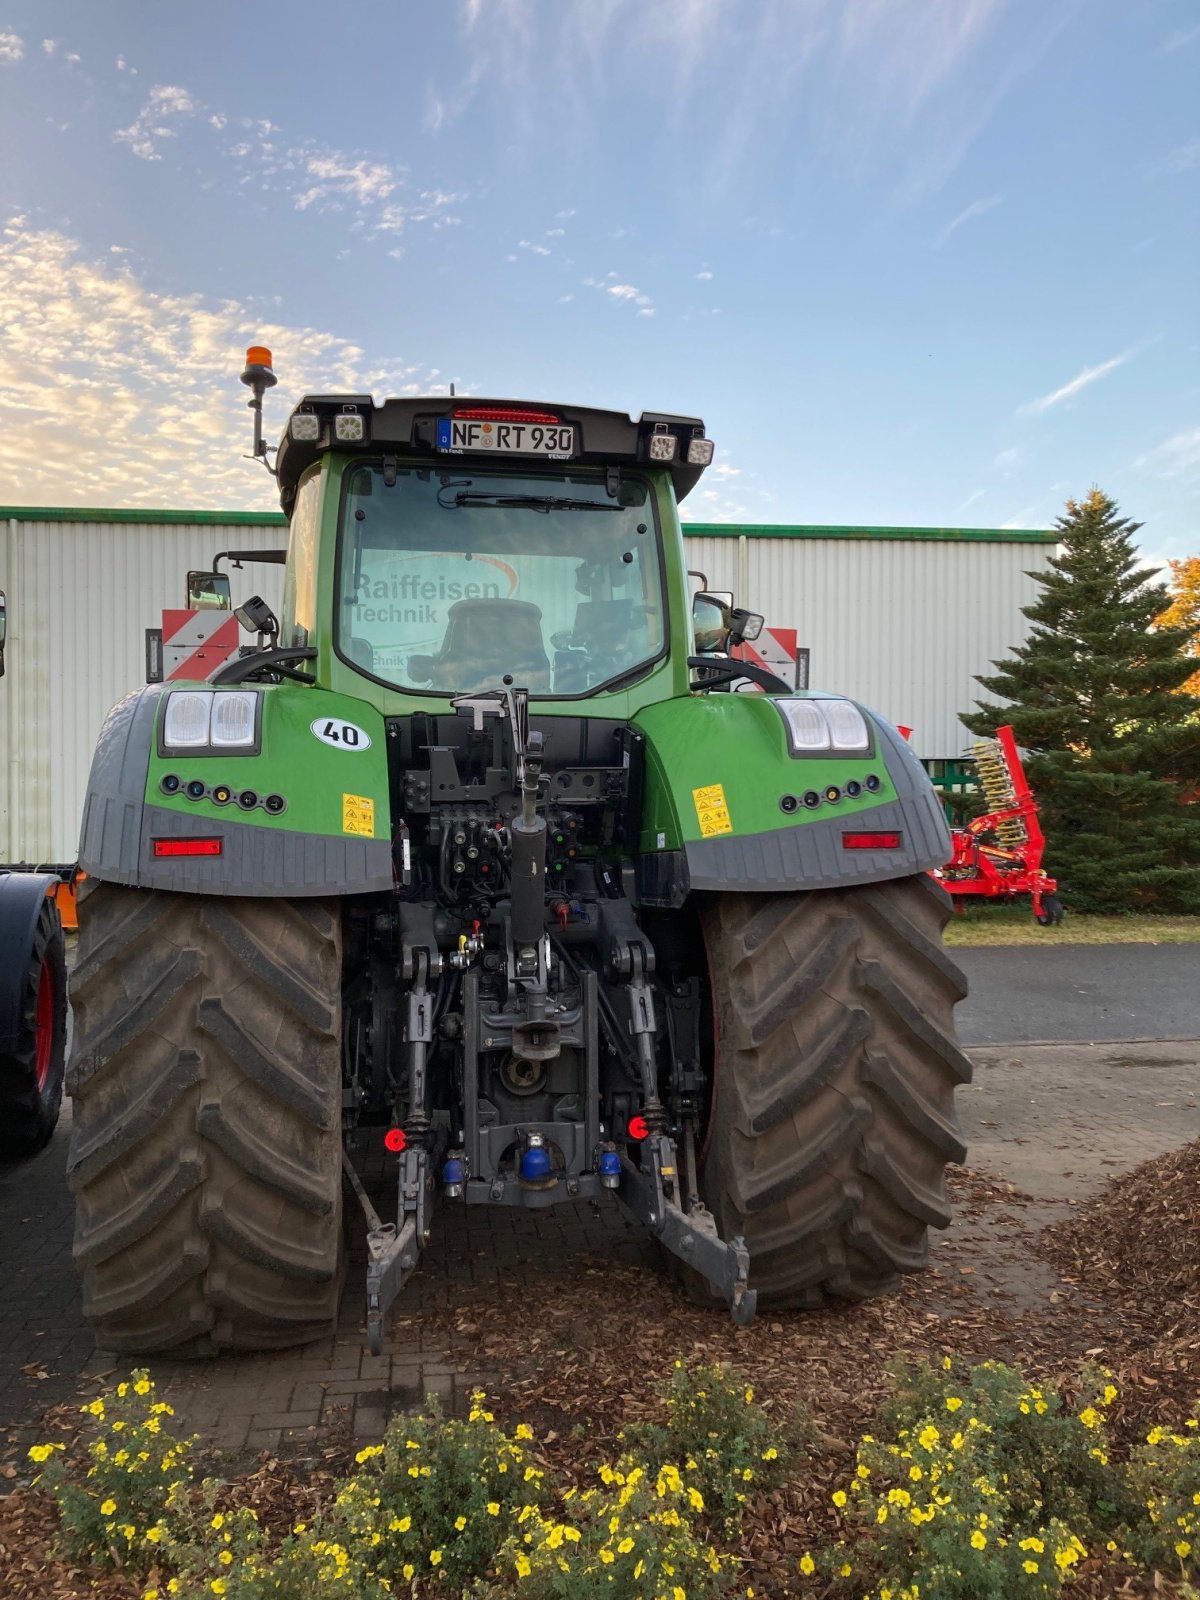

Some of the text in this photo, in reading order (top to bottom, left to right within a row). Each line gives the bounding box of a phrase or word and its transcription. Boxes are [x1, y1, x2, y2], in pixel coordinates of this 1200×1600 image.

[453, 423, 572, 451] NF RT 930
[353, 573, 500, 600] Raiffeisen
[352, 603, 438, 623] Technik
[323, 721, 359, 746] 40
